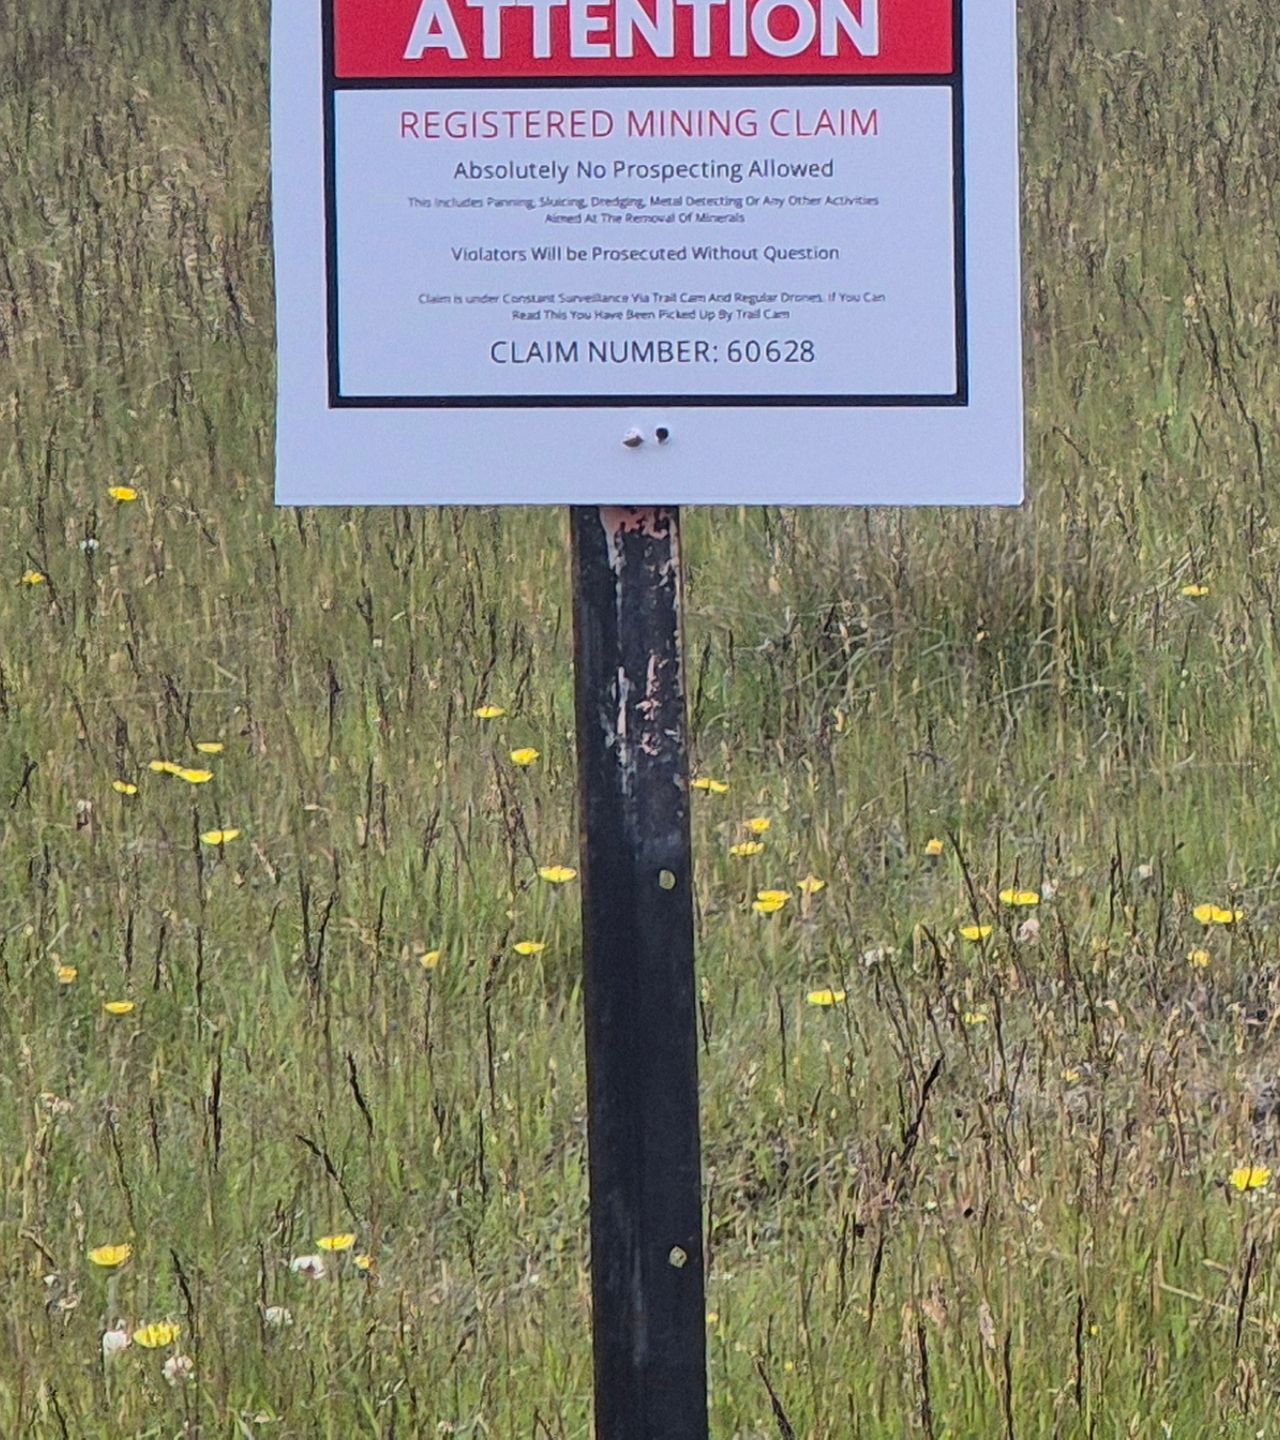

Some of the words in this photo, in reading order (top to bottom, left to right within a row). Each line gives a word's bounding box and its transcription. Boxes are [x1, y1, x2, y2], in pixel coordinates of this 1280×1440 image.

[400, 110, 614, 139] REGISTERED
[627, 109, 758, 137] MINING
[769, 108, 879, 137] CLAIM
[453, 160, 570, 184] Absolutely
[576, 160, 607, 179] No
[613, 159, 744, 184] Prospecting
[748, 158, 834, 178] Allowed
[408, 197, 431, 208] This
[434, 197, 484, 208] Includes
[487, 197, 536, 210] Panning,
[539, 197, 588, 210] Sluicing,
[591, 197, 646, 210] Dredging,
[650, 196, 683, 207] Metal
[686, 196, 743, 209] Detecting
[745, 196, 760, 207] Or
[763, 196, 785, 208] Any
[788, 196, 822, 206] Other
[824, 195, 880, 206] Activities
[545, 213, 582, 223] Aimed
[584, 213, 598, 223] At
[601, 213, 623, 223] The
[625, 212, 676, 223] Removal
[678, 212, 693, 223] Of
[695, 212, 746, 223] Minerals
[451, 246, 527, 261] Violators
[531, 246, 562, 261] Will
[566, 246, 588, 261] be
[592, 246, 688, 261] Prosecuted
[692, 245, 759, 261] Without
[763, 245, 840, 263] Question
[418, 293, 452, 304] Claim
[465, 293, 499, 304] under
[503, 293, 556, 304] Constant
[558, 293, 629, 304] Surveillance
[631, 293, 650, 304] Via
[653, 292, 677, 303] Trail
[680, 293, 706, 303] Cam
[708, 293, 732, 303] And
[734, 292, 778, 305] Regular
[828, 292, 837, 302] If
[839, 292, 861, 303] You
[863, 292, 886, 303] Can
[512, 310, 541, 320] Read
[543, 310, 567, 320] This
[570, 310, 592, 320] You
[594, 310, 623, 320] Have
[626, 309, 655, 320] Been
[659, 309, 696, 320] Picked
[699, 309, 715, 322] Up
[718, 309, 733, 322] By
[736, 309, 761, 319] Trail
[763, 309, 790, 319] Cam
[490, 341, 579, 364] CLAIM
[589, 340, 719, 363] NUMBER:
[727, 340, 815, 363] 60628
